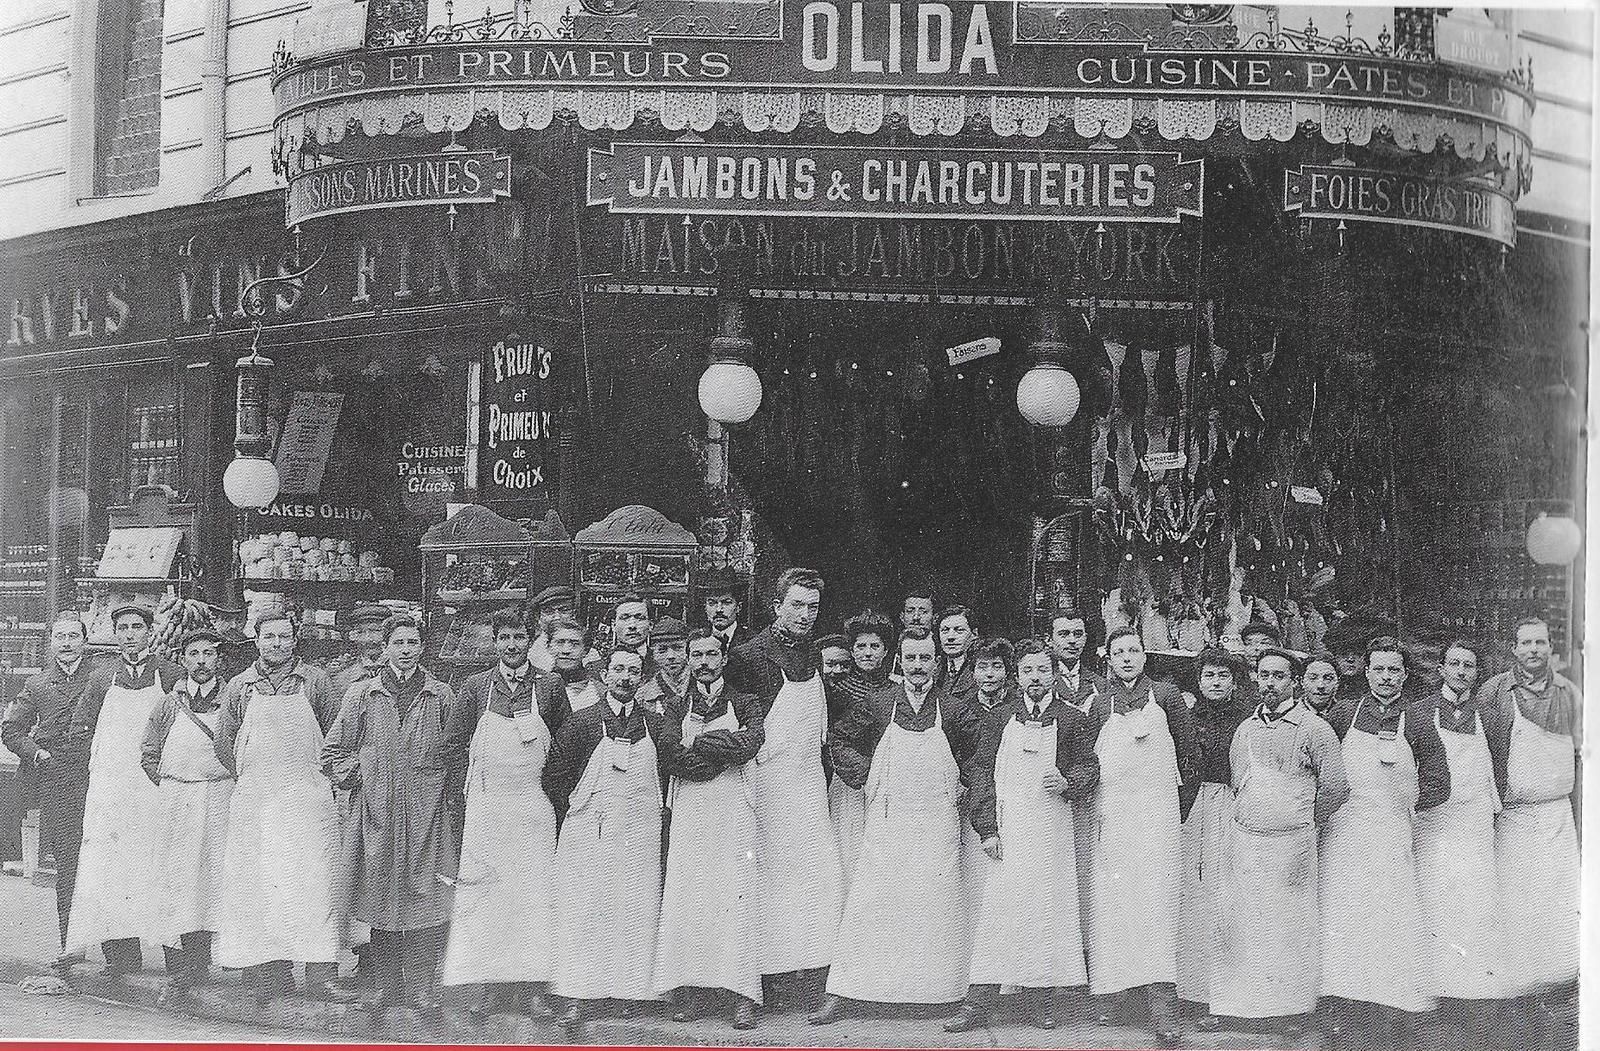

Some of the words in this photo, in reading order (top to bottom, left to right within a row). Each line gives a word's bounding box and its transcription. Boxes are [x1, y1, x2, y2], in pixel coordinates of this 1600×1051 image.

[801, 1, 998, 74] OLIDA
[1451, 41, 1499, 66] DROUOT
[389, 54, 433, 82] ET
[457, 50, 733, 79] PRIMEURS
[1076, 57, 1272, 87] CUISINE
[1447, 79, 1478, 106] ET
[628, 155, 817, 200] JAMBONS
[826, 169, 852, 202] &
[862, 158, 1156, 208] CHARCUTERIES
[1310, 173, 1392, 214] FOIES
[1401, 181, 1458, 222] GRAS
[838, 219, 1015, 279] JAMBON
[513, 389, 528, 402] et
[488, 403, 551, 449] PRIMEU
[512, 446, 526, 459] de
[407, 476, 456, 493] Glaces
[493, 459, 544, 489] Choix
